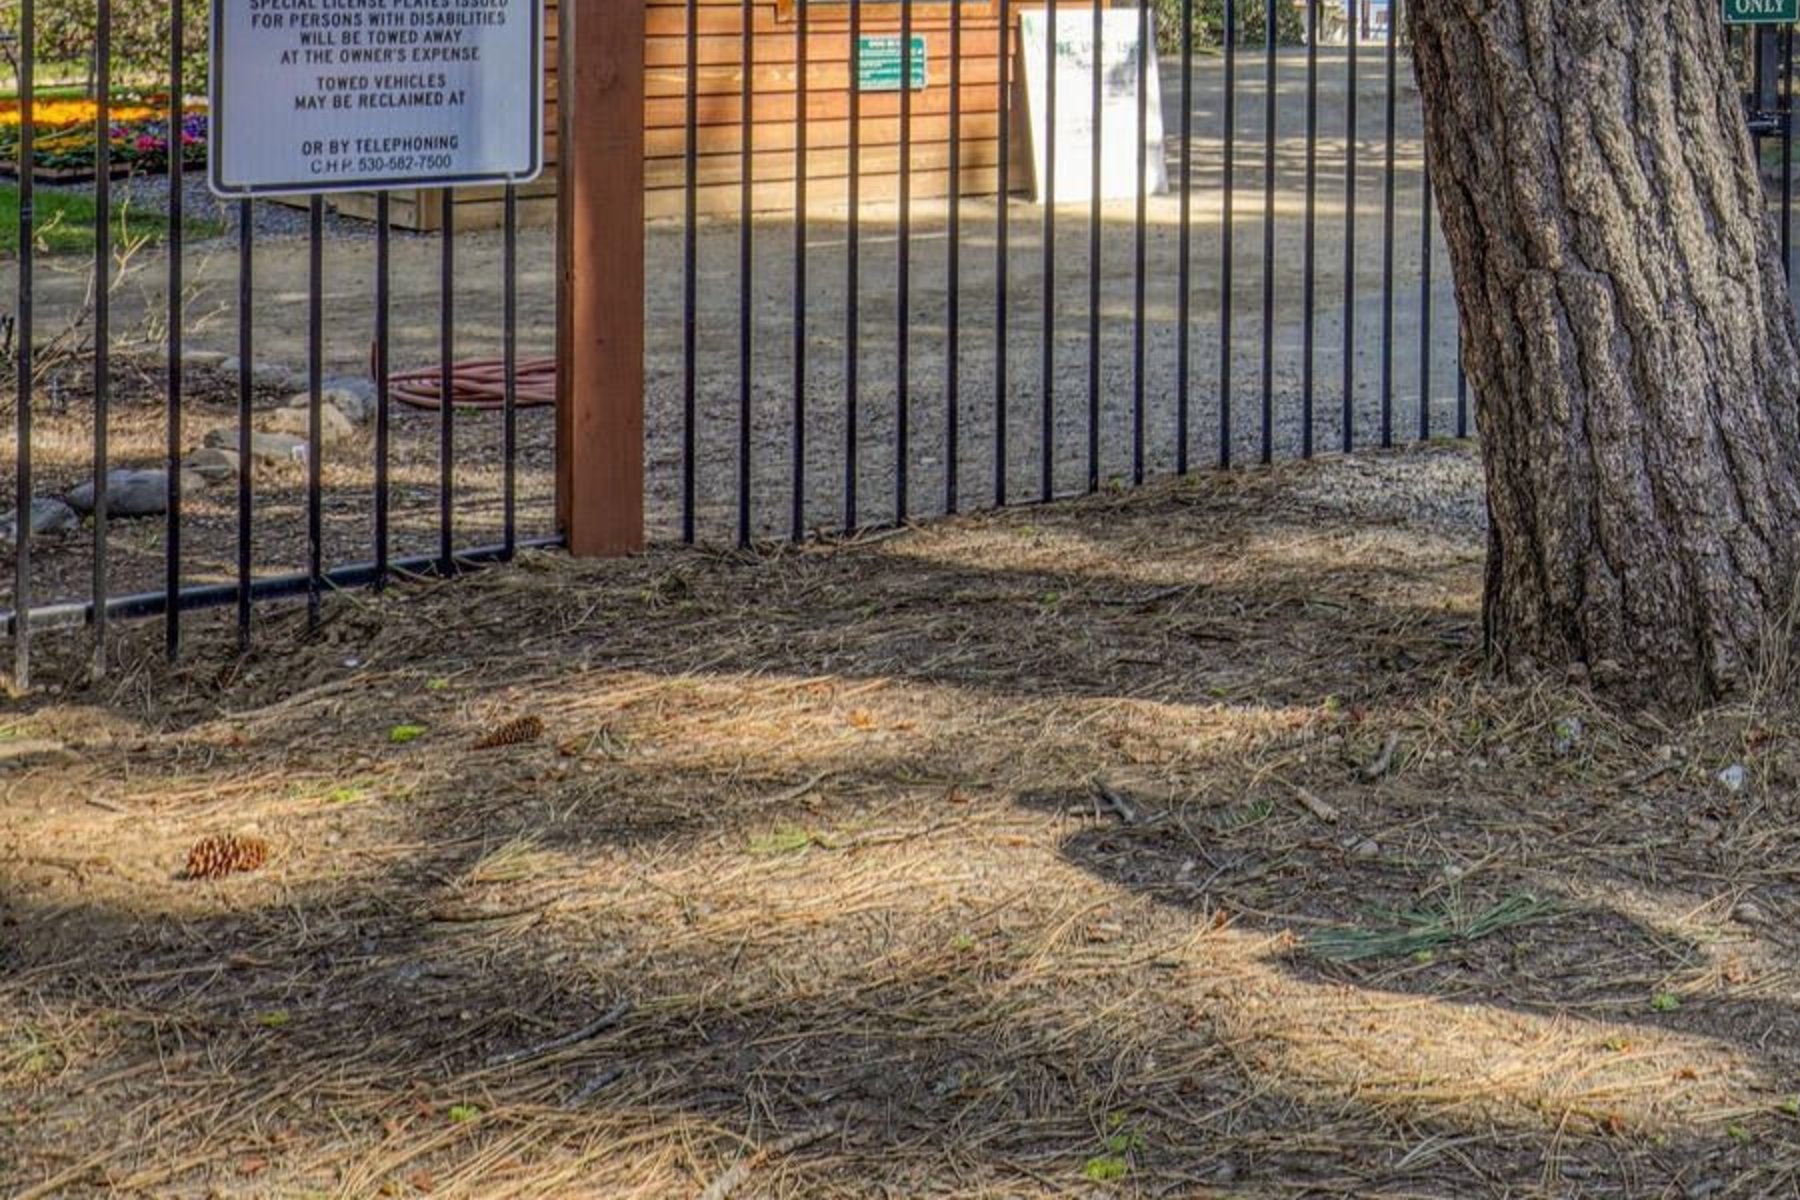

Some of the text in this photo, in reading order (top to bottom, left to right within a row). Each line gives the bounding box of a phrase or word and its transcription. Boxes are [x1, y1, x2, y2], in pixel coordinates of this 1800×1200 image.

[252, 11, 506, 29] FOR PERSONS WITH DISABILITIES
[300, 29, 463, 46] WILL BE TOWED AWAY
[280, 47, 480, 65] AT THE OWNER'S EXPENSE
[317, 73, 446, 91] TOWED VEHICLES
[295, 91, 466, 110] MAY BE RECLAIMED AT
[302, 135, 459, 156] OR BY TELEPHONING
